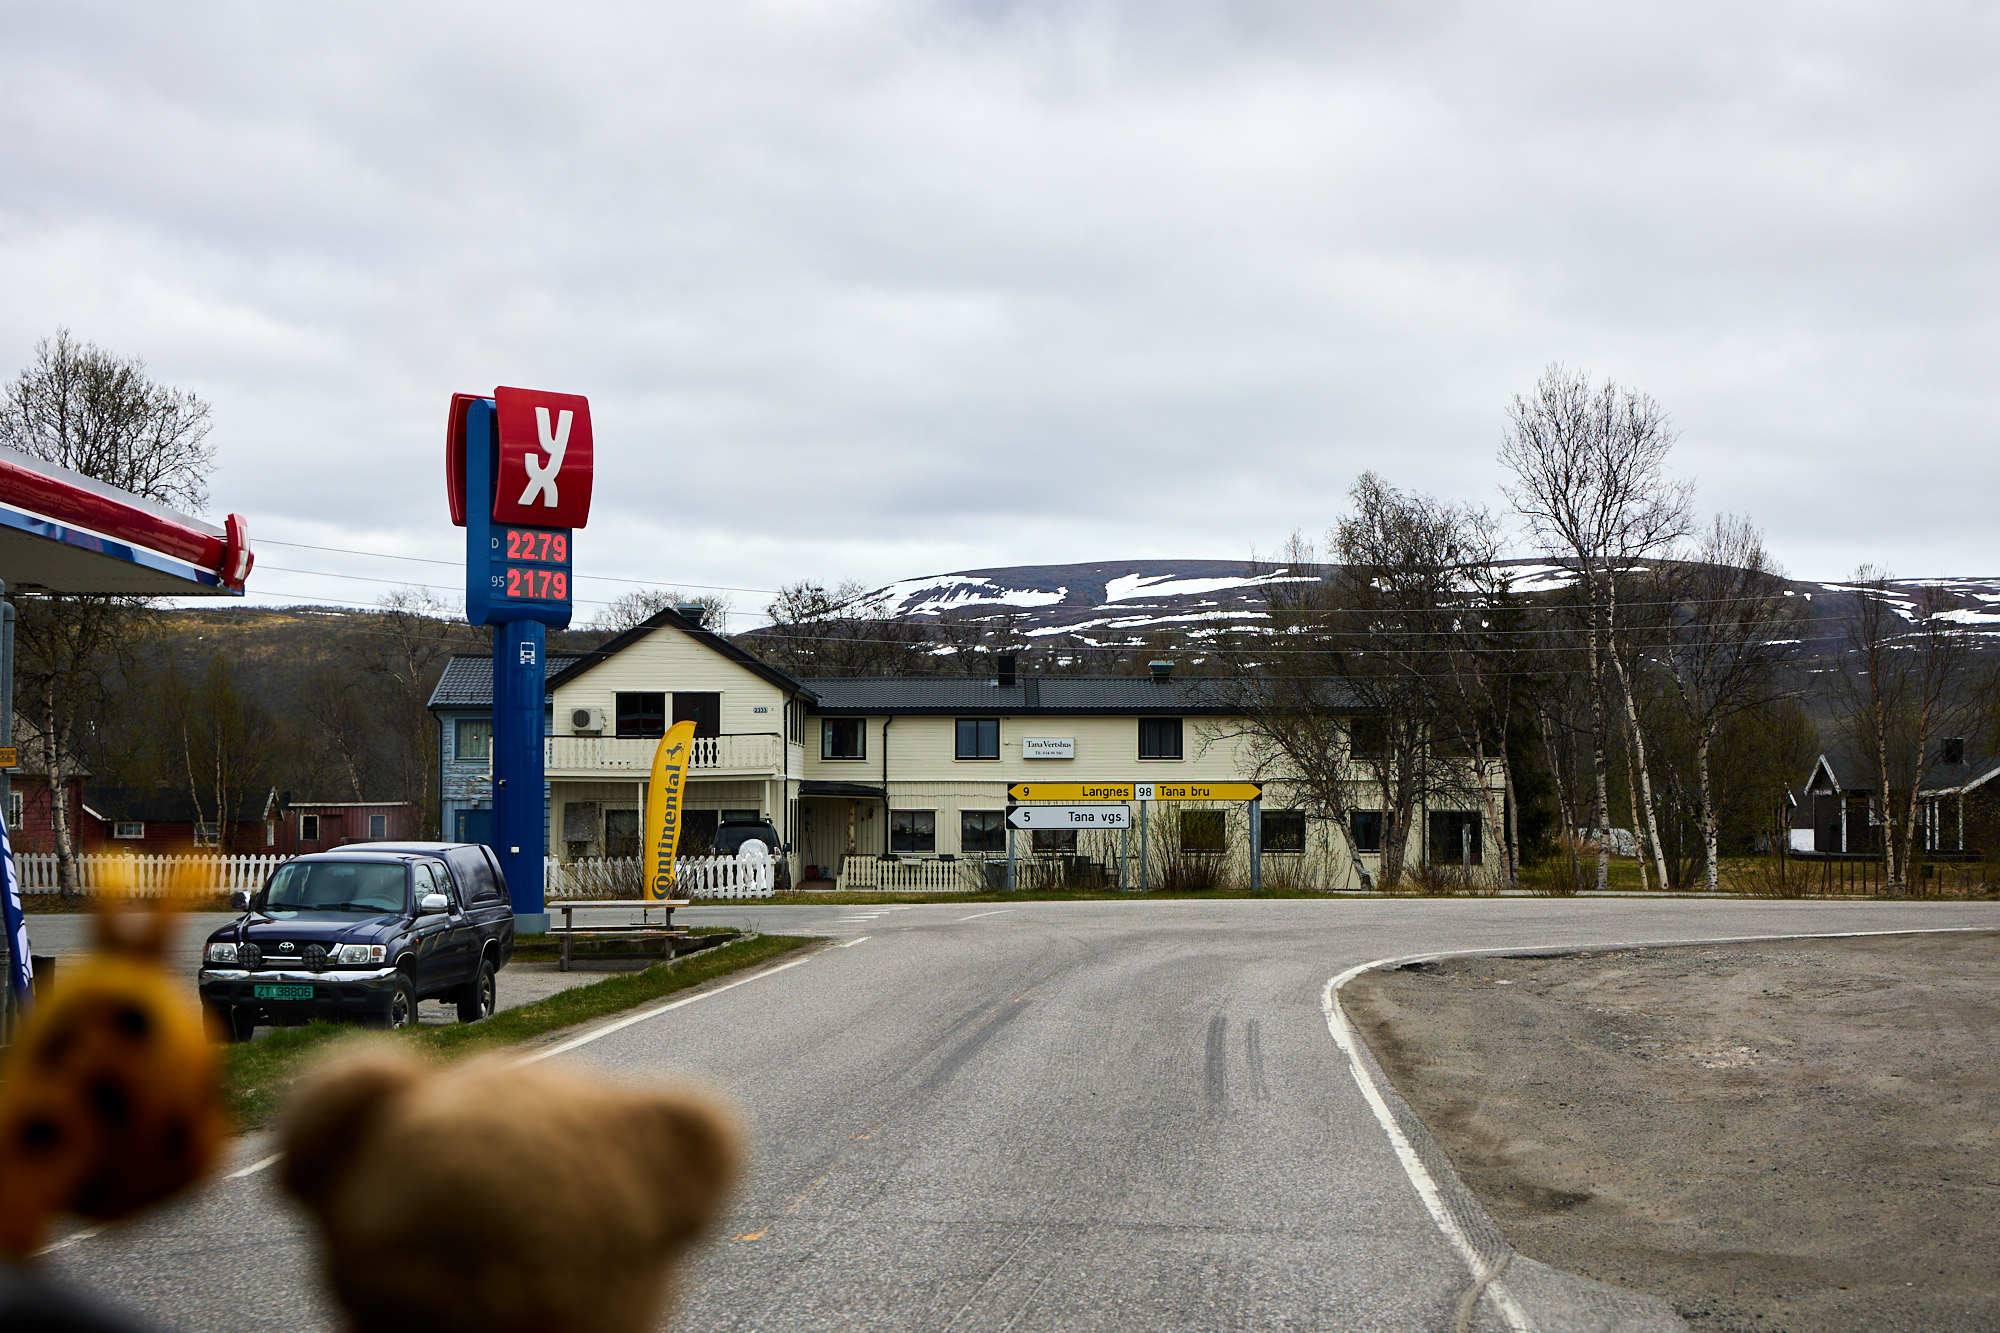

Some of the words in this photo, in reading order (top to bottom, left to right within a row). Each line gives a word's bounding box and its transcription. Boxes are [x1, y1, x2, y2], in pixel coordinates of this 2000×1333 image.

[491, 537, 499, 549] D
[506, 530, 567, 562] 22.79
[491, 575, 505, 588] 95
[506, 568, 567, 599] 21.79
[1026, 740, 1043, 748] Tana
[1043, 740, 1072, 748] Vertshus
[1023, 786, 1030, 797] 9
[1082, 786, 1129, 799] Langnes
[1138, 787, 1152, 797] 98
[1159, 786, 1186, 797] Tana
[1191, 786, 1210, 797] bru
[1023, 812, 1031, 822] 5
[1068, 811, 1095, 822] Tana
[1101, 813, 1125, 825] vgs.
[651, 764, 682, 900] Continental
[257, 986, 271, 996] ZT
[277, 987, 311, 997] 38806
